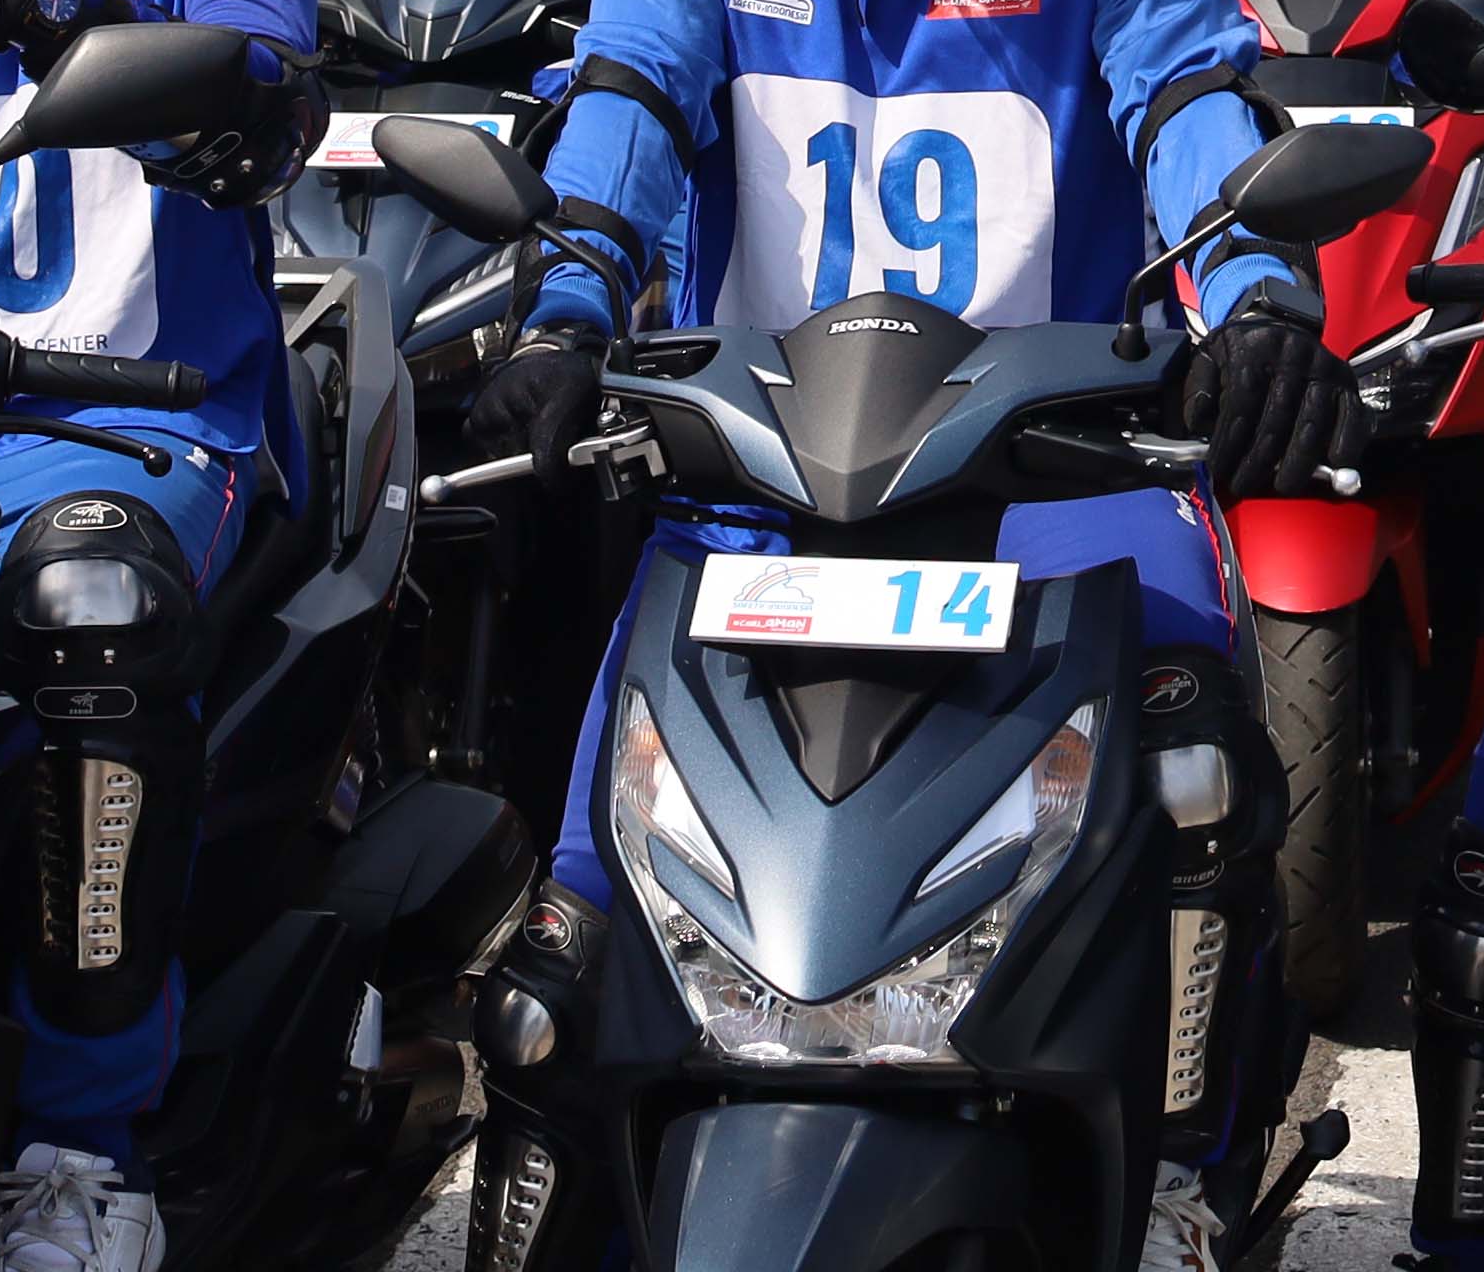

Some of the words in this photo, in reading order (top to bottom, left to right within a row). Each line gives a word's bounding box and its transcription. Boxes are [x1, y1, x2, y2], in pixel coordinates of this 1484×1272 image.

[807, 122, 977, 320] 19
[828, 318, 920, 334] HONDA
[887, 569, 993, 637] 14
